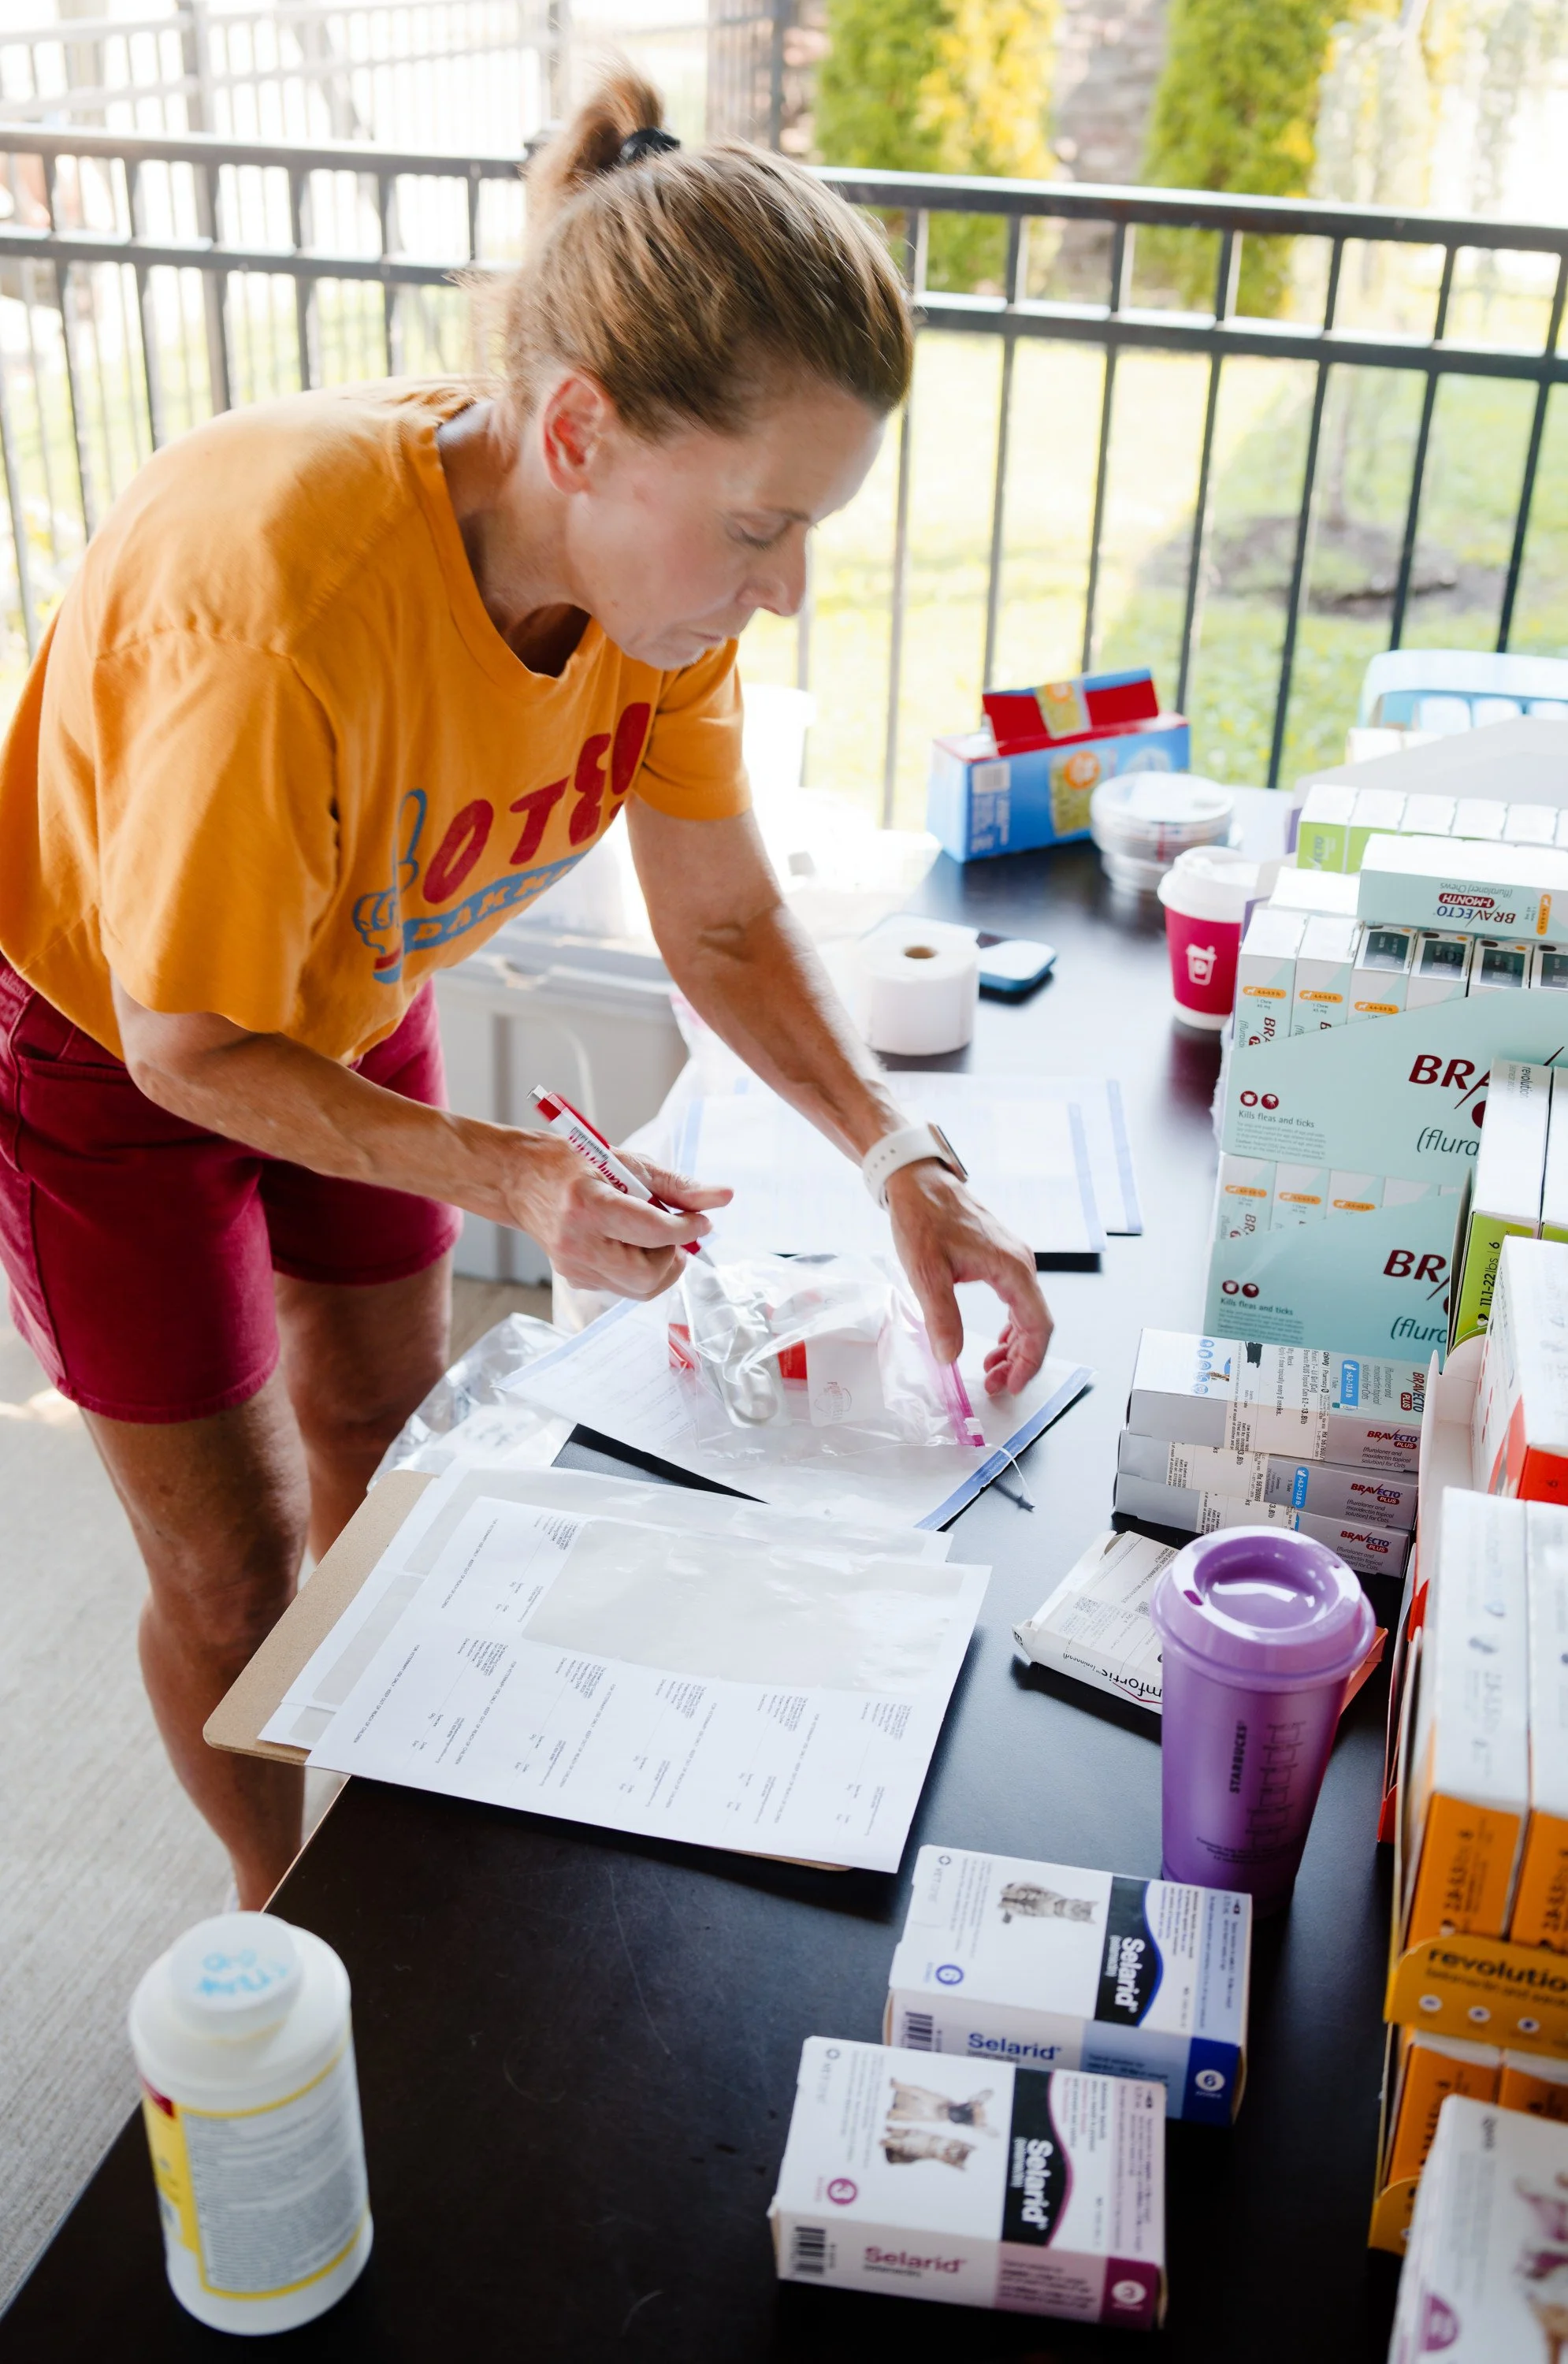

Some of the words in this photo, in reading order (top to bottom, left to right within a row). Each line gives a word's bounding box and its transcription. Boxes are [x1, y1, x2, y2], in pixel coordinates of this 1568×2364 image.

[1440, 883, 1466, 893] Chews
[1441, 894, 1492, 908] 1-MONTH
[1436, 905, 1516, 927] BRAVECTO
[1239, 1110, 1254, 1119] Kills
[1258, 1113, 1276, 1122] fleas
[1297, 1119, 1314, 1128] ticks
[1489, 1241, 1500, 1250] 6
[1383, 1250, 1449, 1300] BR
[1221, 1298, 1236, 1307] Kills
[1239, 1300, 1256, 1310] fleas
[1406, 1371, 1425, 1413] BRAVECTO
[1402, 1394, 1410, 1409] PLUS
[1367, 1429, 1418, 1442] BRAVECTO
[1362, 1447, 1391, 1455] (fluralaner
[1351, 1485, 1401, 1498] BRAVECTO
[1347, 1499, 1373, 1509] (fluralaner
[1347, 1505, 1375, 1515] moxidectin
[1345, 1511, 1369, 1520] solution)
[1340, 1530, 1389, 1547] BRAVECTO
[1336, 1546, 1363, 1556] (fluralaner
[1365, 1557, 1384, 1567] topical
[1229, 1723, 1247, 1793] STARBUCKS
[1114, 1936, 1145, 2008] Selarid
[968, 2031, 1056, 2061] Selarid
[1021, 2139, 1053, 2224] Selarid
[864, 2246, 960, 2273] Selarid
